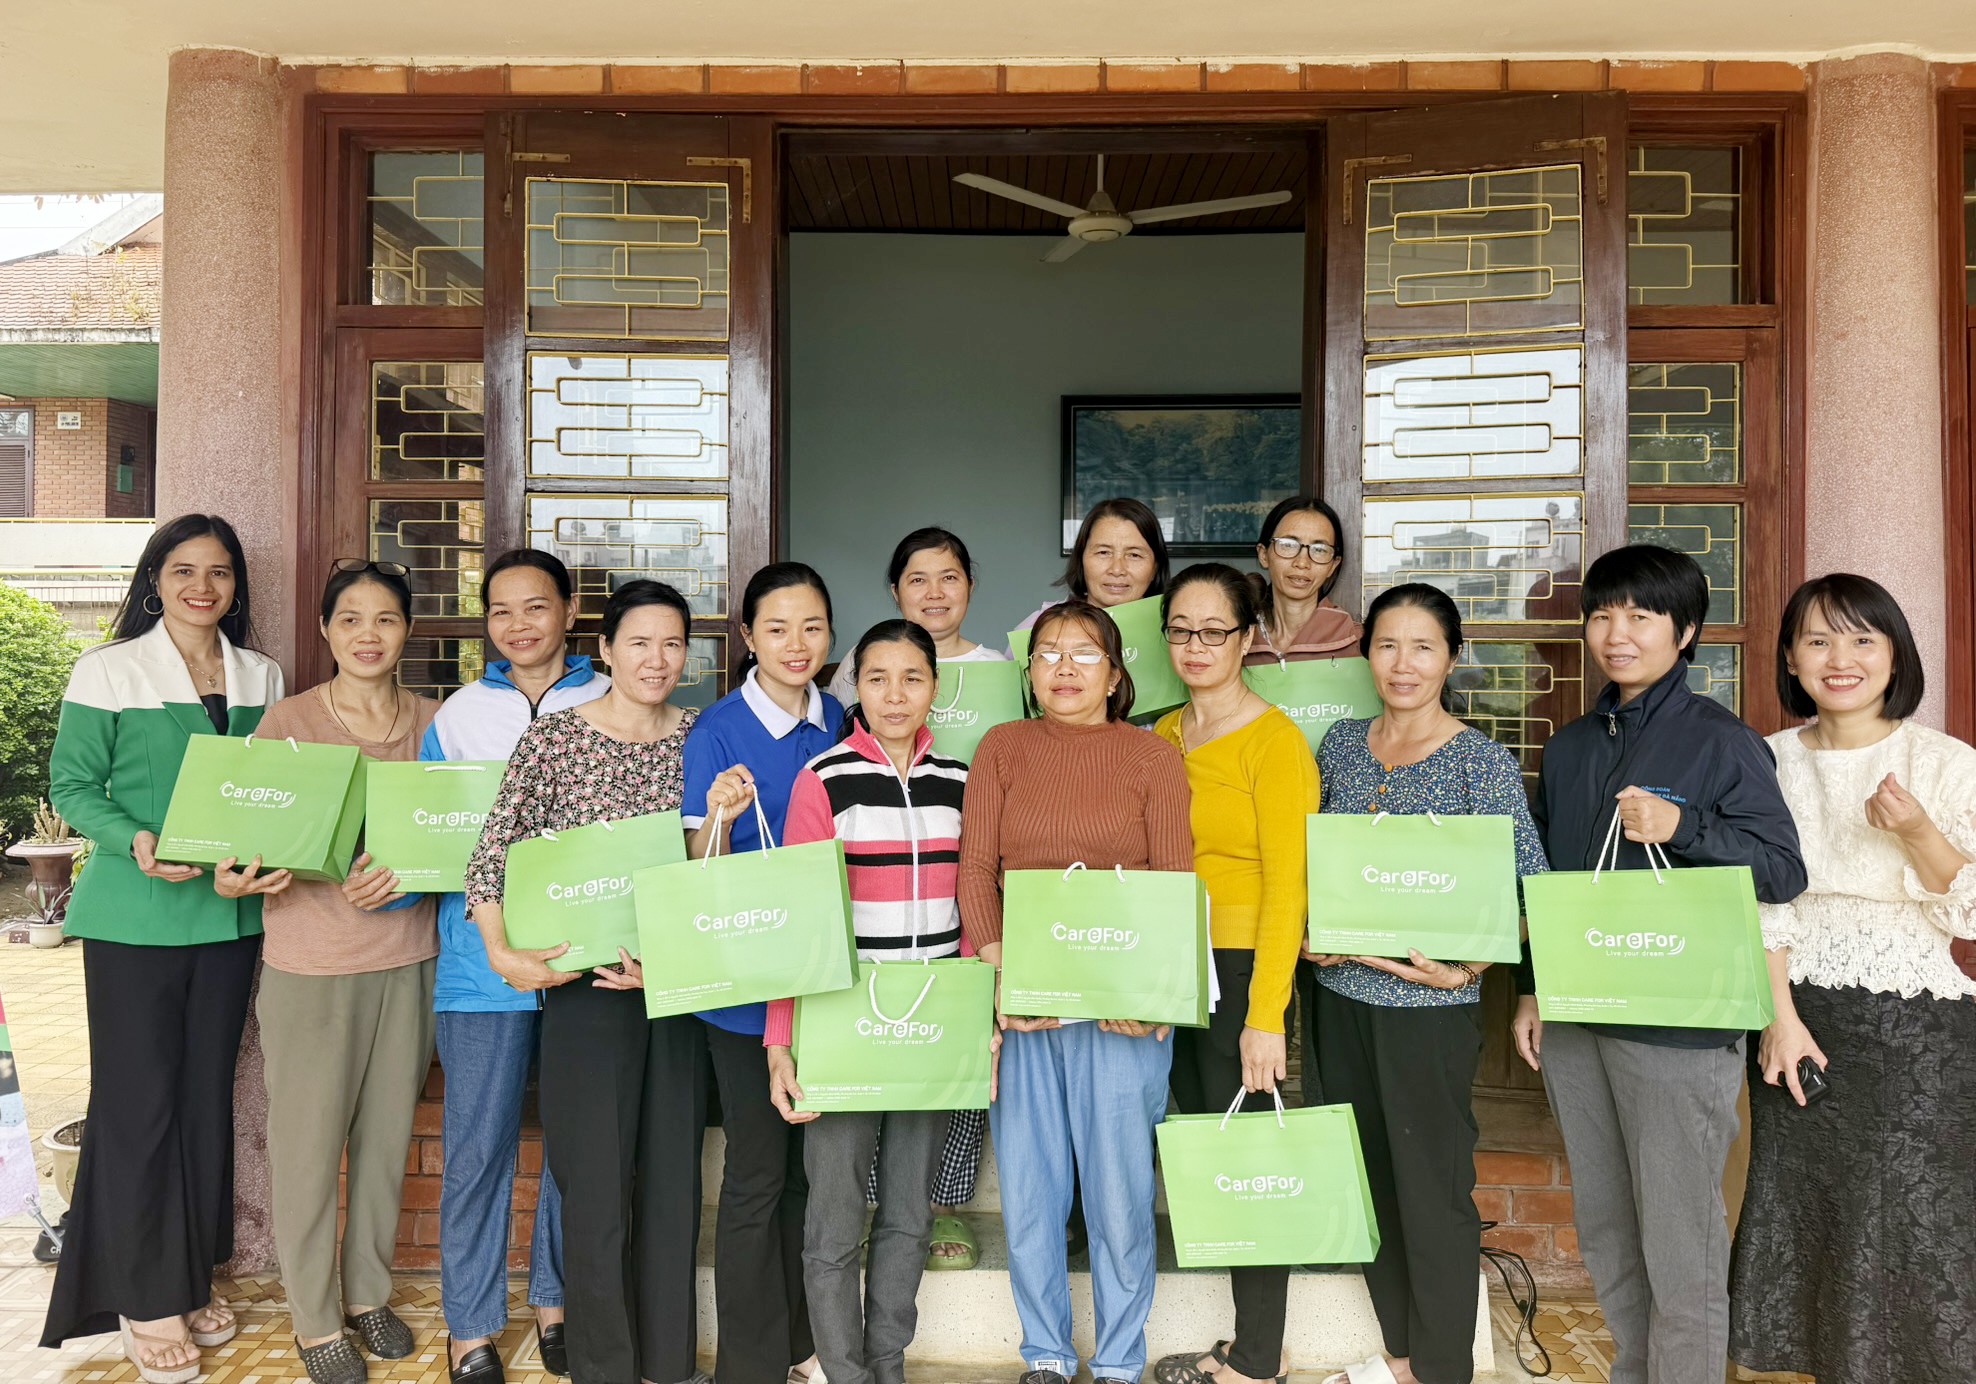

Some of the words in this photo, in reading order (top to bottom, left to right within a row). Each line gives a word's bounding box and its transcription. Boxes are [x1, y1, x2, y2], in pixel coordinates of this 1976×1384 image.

[926, 708, 973, 723] reFor
[221, 783, 293, 802] CareFor
[415, 810, 489, 827] CareFor
[1363, 867, 1450, 887] CareFor
[549, 876, 629, 900] CareFor
[696, 908, 781, 932] CareFor
[1053, 924, 1134, 944] CareFor
[1587, 930, 1678, 949] CareFor
[857, 1018, 938, 1038] CareFor
[1216, 1175, 1297, 1193] CareFor
